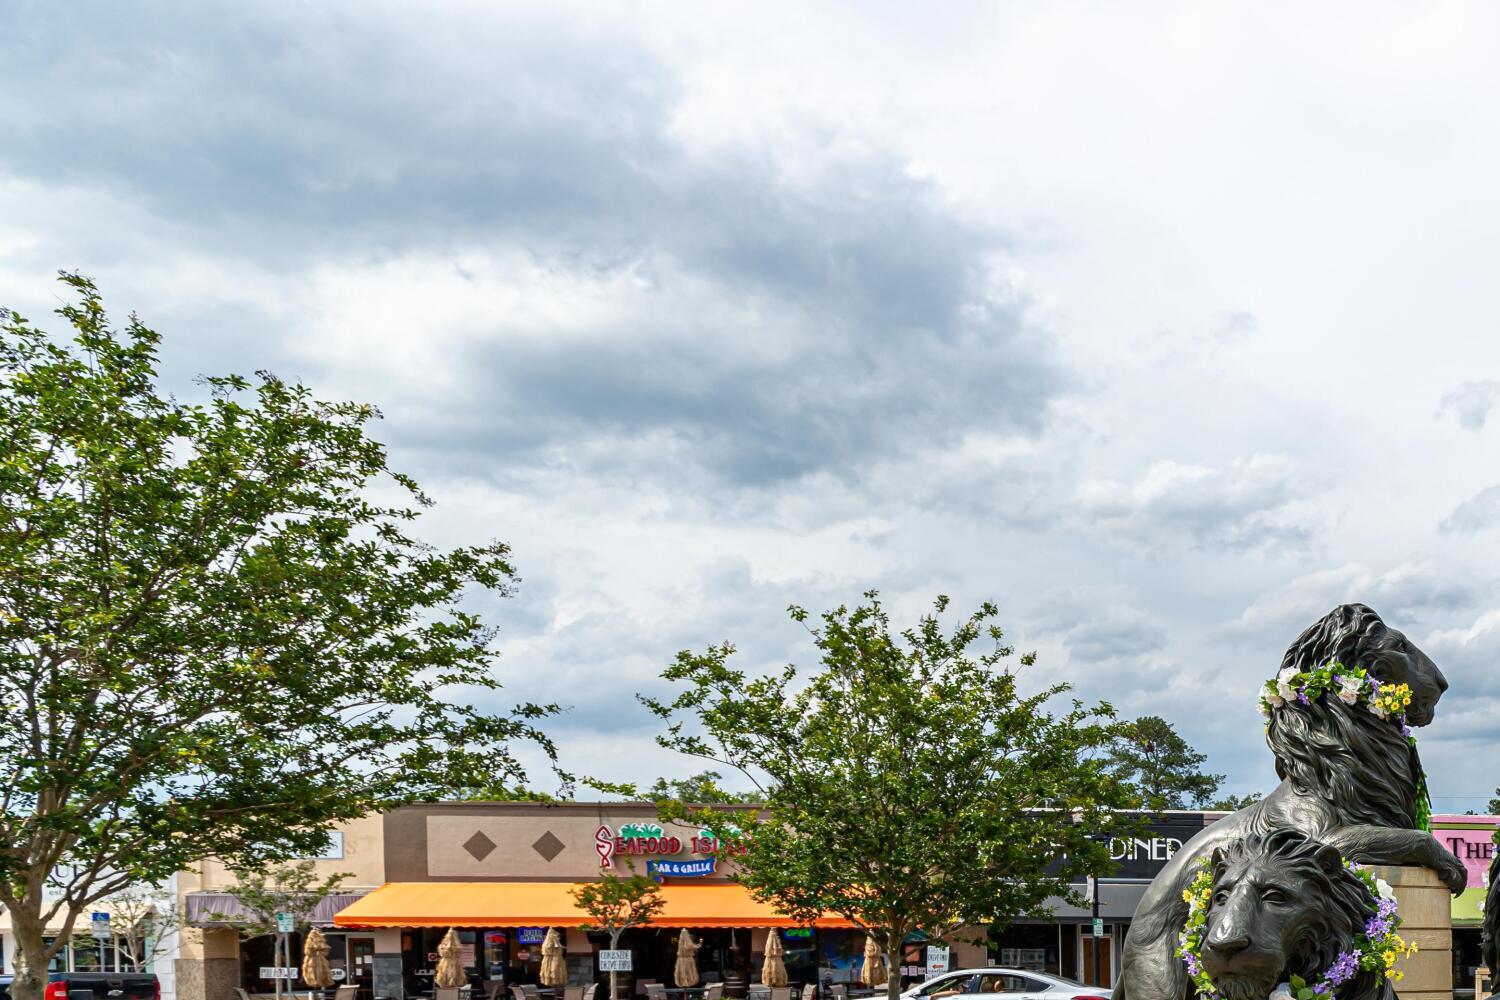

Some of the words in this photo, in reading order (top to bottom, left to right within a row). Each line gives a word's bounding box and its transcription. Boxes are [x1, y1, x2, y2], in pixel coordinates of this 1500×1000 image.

[595, 825, 682, 868] SEAFOOD
[1110, 838, 1183, 860] DINER
[1447, 837, 1494, 859] THE
[673, 864, 680, 873] &
[681, 863, 711, 874] GRILLE
